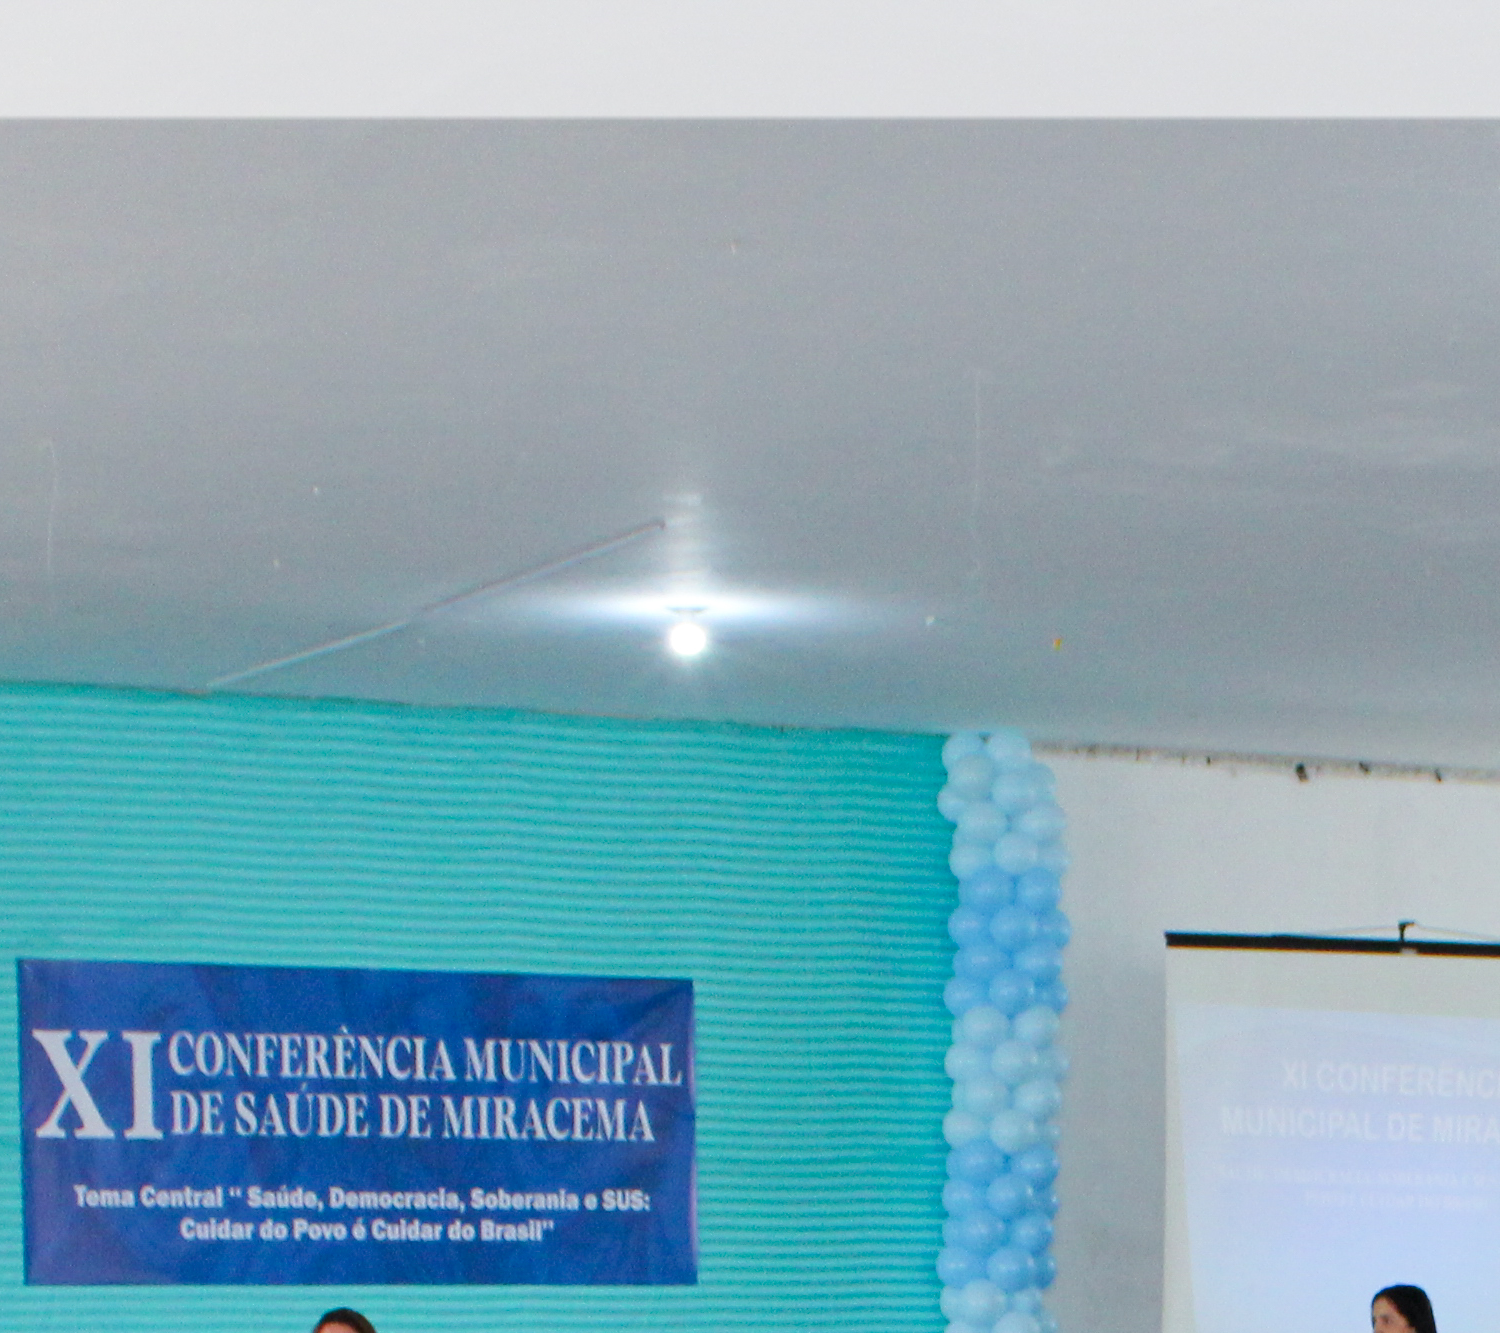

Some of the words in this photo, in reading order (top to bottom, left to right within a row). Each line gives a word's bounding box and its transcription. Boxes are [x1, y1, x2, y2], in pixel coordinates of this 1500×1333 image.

[32, 1029, 165, 1141] XI
[167, 1027, 457, 1083] CONFERÊNCIA
[463, 1038, 684, 1087] MUNICIPAL
[1282, 1060, 1308, 1089] XI
[172, 1091, 225, 1137] DE
[235, 1084, 369, 1139] SAÚDE
[380, 1094, 433, 1139] DE
[441, 1096, 656, 1143] MIRACEMA
[1220, 1105, 1380, 1142] MUNICIPAL
[1386, 1113, 1424, 1143] DE
[74, 1184, 134, 1208] Tema
[141, 1184, 223, 1209] Central
[247, 1185, 325, 1212] Saúde,
[328, 1187, 466, 1212] Democracia,
[470, 1188, 579, 1211] Soberania
[584, 1195, 598, 1211] e
[601, 1190, 651, 1211] SUS:
[180, 1217, 255, 1241] Cuidar
[259, 1217, 289, 1241] do
[293, 1218, 347, 1242] Povo
[352, 1217, 367, 1241] é
[371, 1218, 443, 1242] Cuidar
[446, 1218, 476, 1242] do
